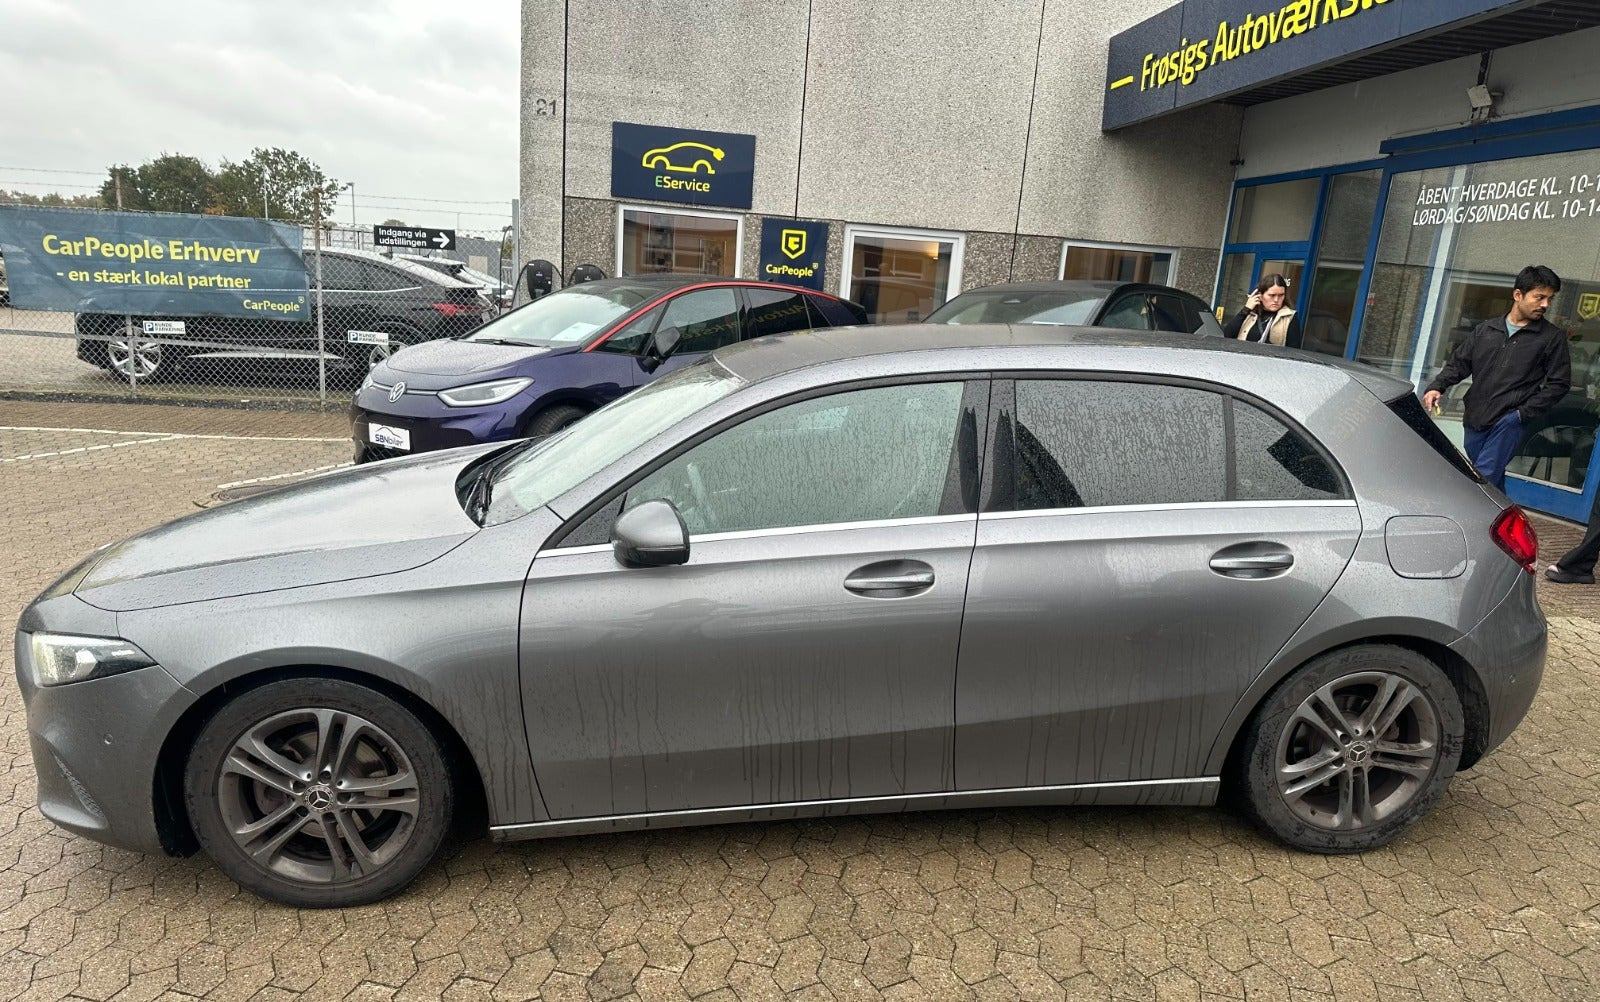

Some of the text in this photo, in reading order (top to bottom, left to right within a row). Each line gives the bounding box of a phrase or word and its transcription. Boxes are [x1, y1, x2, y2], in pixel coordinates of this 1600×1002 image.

[1140, 0, 1389, 92] Frøsigs Autovær
[536, 98, 557, 116] 21
[655, 175, 711, 192] EService
[1416, 185, 1460, 206] ÅBENT
[1460, 178, 1538, 202] HVERDAGE
[1539, 177, 1562, 196] KL.
[1412, 202, 1531, 226] LØRDAG/SØNDAG
[1532, 201, 1555, 220] KL.
[378, 227, 427, 239] Indgang via
[42, 234, 260, 264] CarPeople Erhverv
[378, 237, 427, 248] udstillingen
[68, 270, 90, 282] en
[93, 269, 142, 285] stærk
[144, 270, 184, 286] lokal
[187, 273, 252, 290] partner
[765, 263, 814, 279] CarPeople
[242, 299, 300, 314] CarPeople
